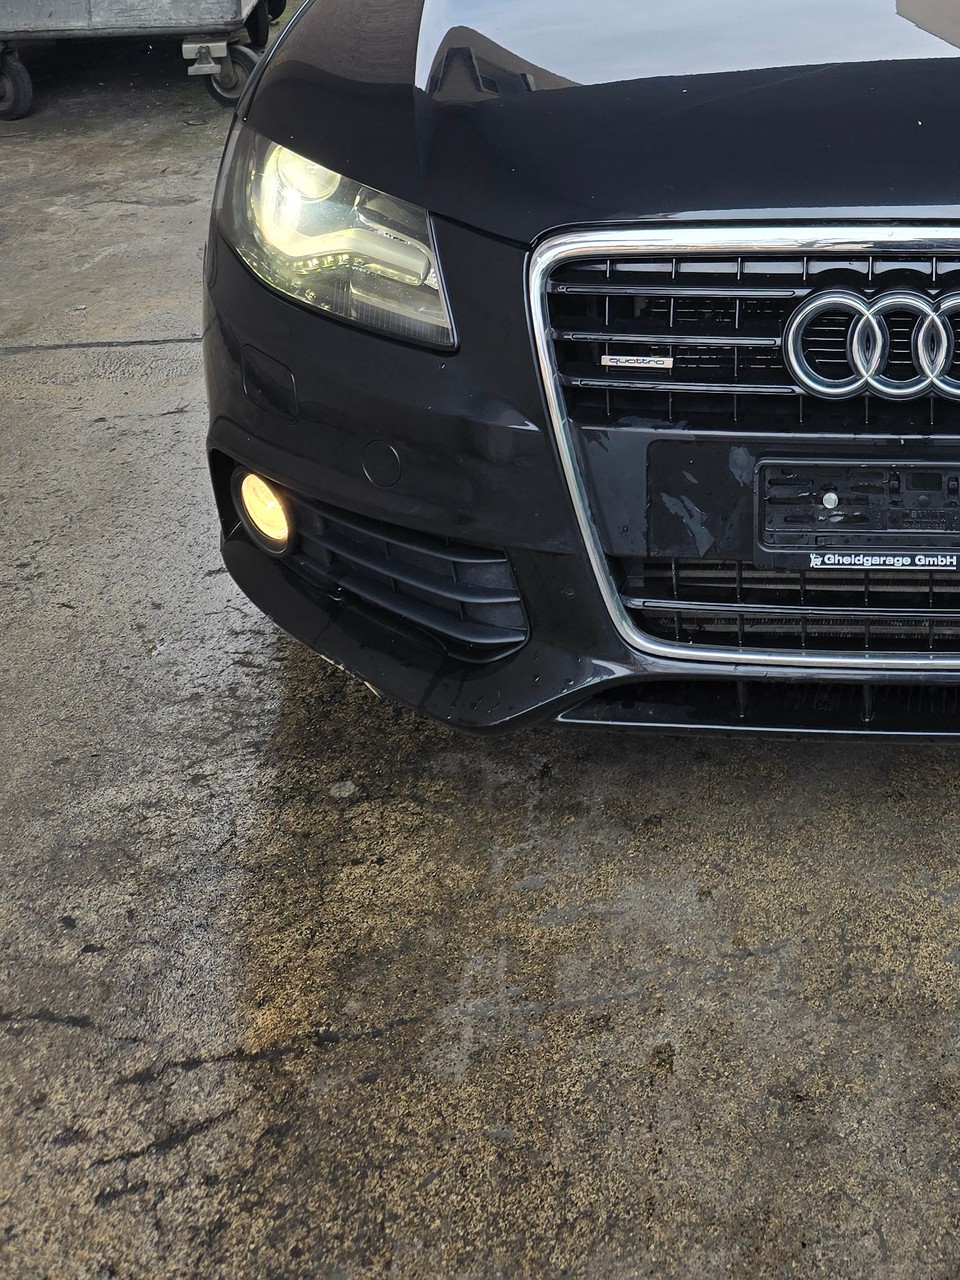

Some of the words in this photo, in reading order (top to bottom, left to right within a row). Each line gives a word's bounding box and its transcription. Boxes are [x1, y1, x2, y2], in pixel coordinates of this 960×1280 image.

[608, 357, 664, 365] quattro
[824, 554, 911, 567] Gheidgarage
[914, 555, 957, 566] GmbH
